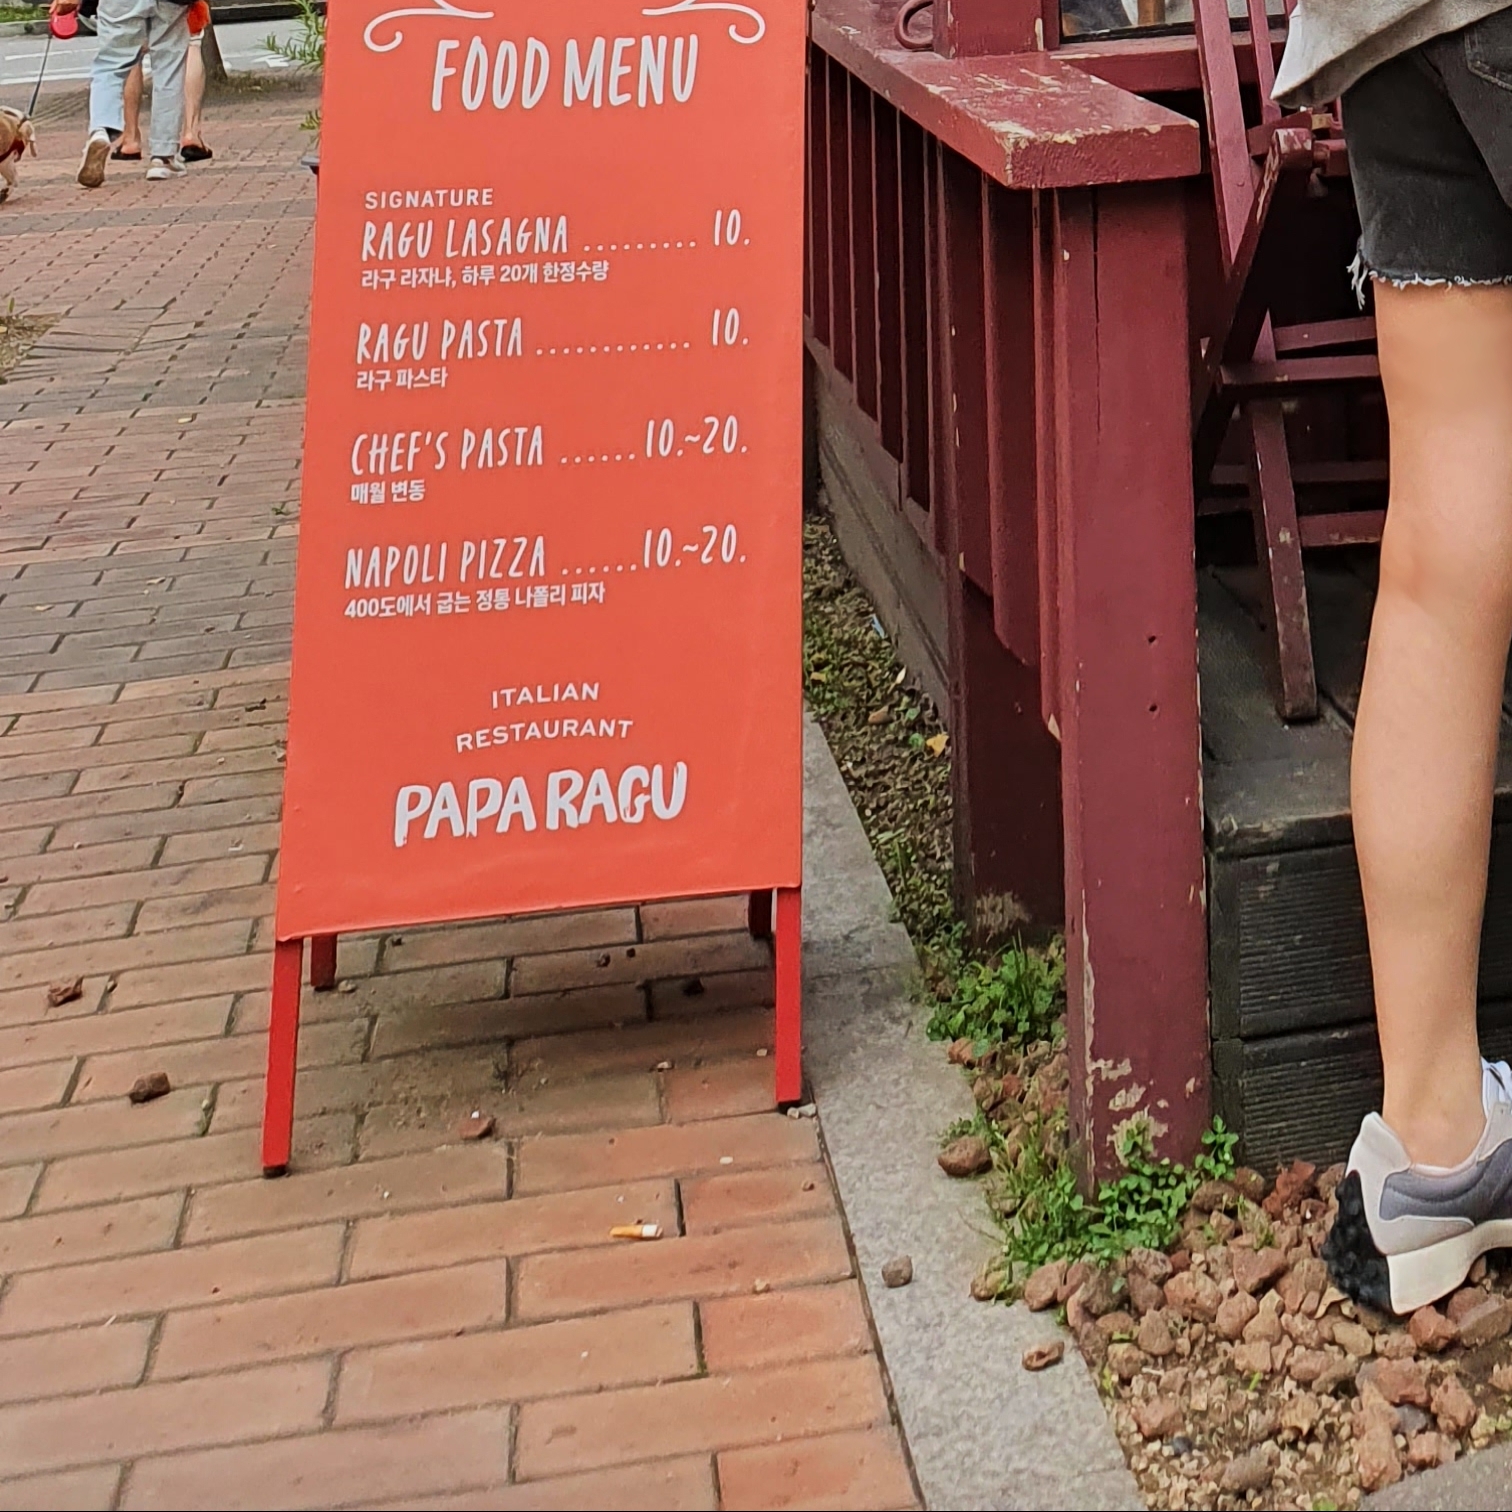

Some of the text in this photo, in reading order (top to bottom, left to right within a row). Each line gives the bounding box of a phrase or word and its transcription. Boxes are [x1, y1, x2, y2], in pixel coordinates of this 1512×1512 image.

[432, 33, 698, 112] FOOD MENU
[364, 188, 494, 210] SIGNATURE
[361, 219, 434, 262] RAGU
[445, 215, 568, 258] LASAGNA
[361, 268, 396, 290] 라구
[461, 264, 496, 286] 하루
[499, 262, 538, 285] 20개
[542, 260, 610, 284] 한정수량
[356, 321, 429, 364] RAGU
[440, 317, 524, 361] PASTA
[356, 366, 449, 392] 라구 파스타
[351, 430, 449, 476] CHEF'S
[460, 425, 544, 470] PASTA
[350, 478, 426, 504] 매월 변동
[344, 542, 448, 590] NAPOLI
[460, 535, 546, 582] PIZZA
[344, 581, 606, 619] 400도에서 굽는 정통 나폴리 피자
[492, 682, 600, 710] ITALIAN
[456, 718, 634, 754] RESTAURANT
[394, 761, 688, 848] PAPA RAGU
